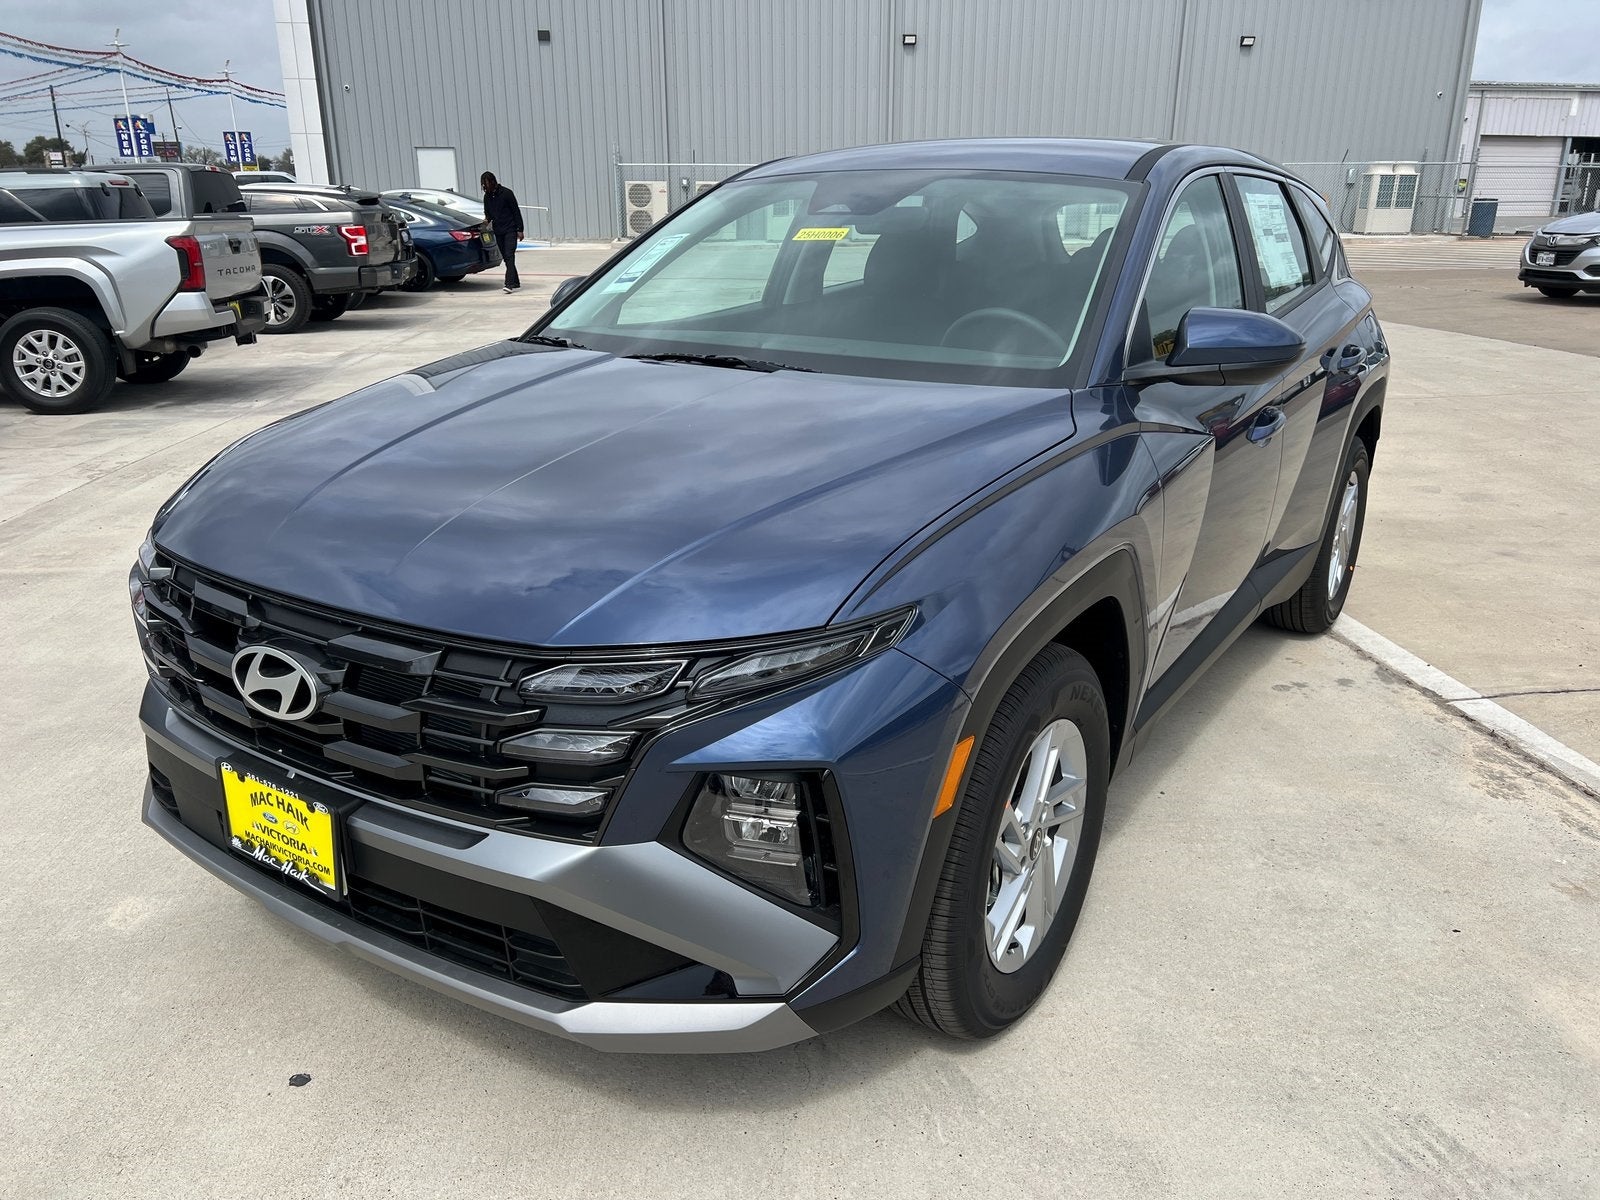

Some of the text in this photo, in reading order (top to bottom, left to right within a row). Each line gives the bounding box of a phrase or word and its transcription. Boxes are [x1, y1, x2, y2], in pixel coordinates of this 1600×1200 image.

[120, 133, 131, 155] NEW
[139, 133, 149, 156] FORD
[217, 264, 256, 276] TACOMA
[250, 791, 274, 807] MAC
[275, 795, 311, 832] HAIK
[258, 822, 309, 855] VICTORIA
[250, 847, 281, 869] Mac
